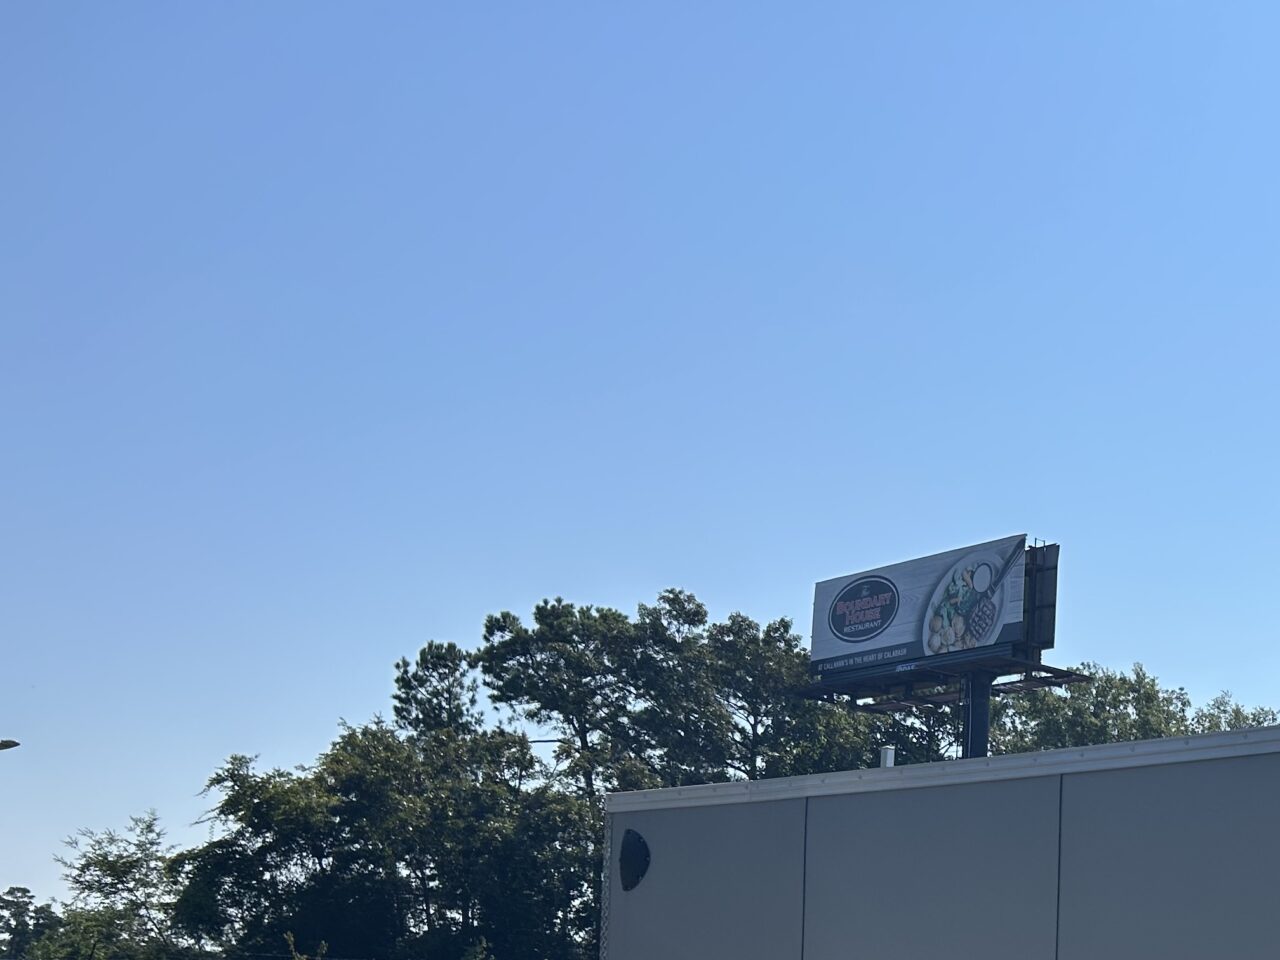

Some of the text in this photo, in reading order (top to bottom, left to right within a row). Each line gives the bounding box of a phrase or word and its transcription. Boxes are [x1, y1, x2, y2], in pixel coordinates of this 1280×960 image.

[845, 607, 881, 625] HOUSE
[843, 619, 882, 633] RESTAURANT
[863, 655, 877, 663] HEART
